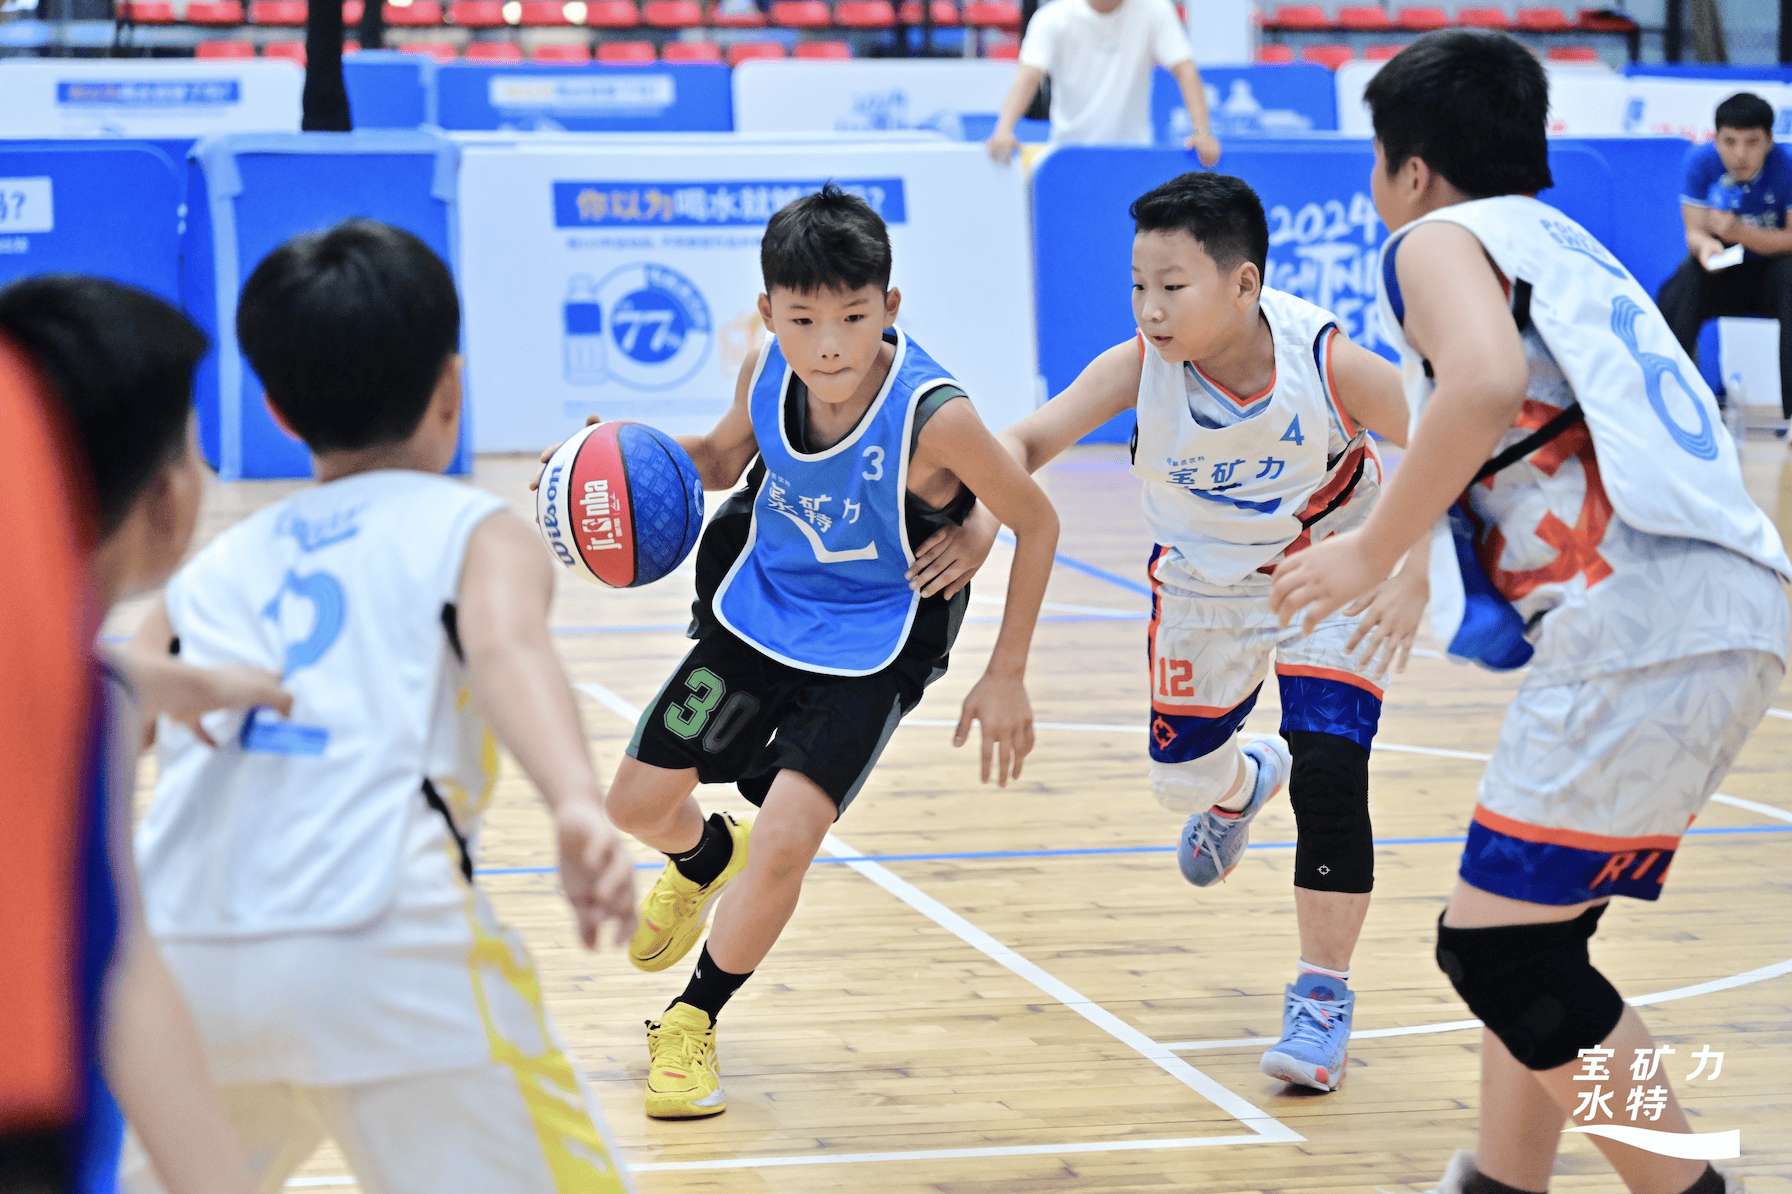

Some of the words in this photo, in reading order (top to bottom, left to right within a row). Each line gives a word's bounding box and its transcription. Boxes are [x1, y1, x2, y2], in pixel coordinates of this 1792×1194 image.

[1268, 190, 1380, 247] 2024
[1279, 413, 1305, 446] 4
[862, 445, 885, 481] 3
[1166, 456, 1285, 485] 宝矿力
[543, 461, 576, 568] Wilson
[579, 479, 610, 516] nba
[587, 533, 623, 551] jr.
[1158, 657, 1195, 697] 12
[664, 666, 760, 754] 30
[1588, 852, 1673, 890] RI
